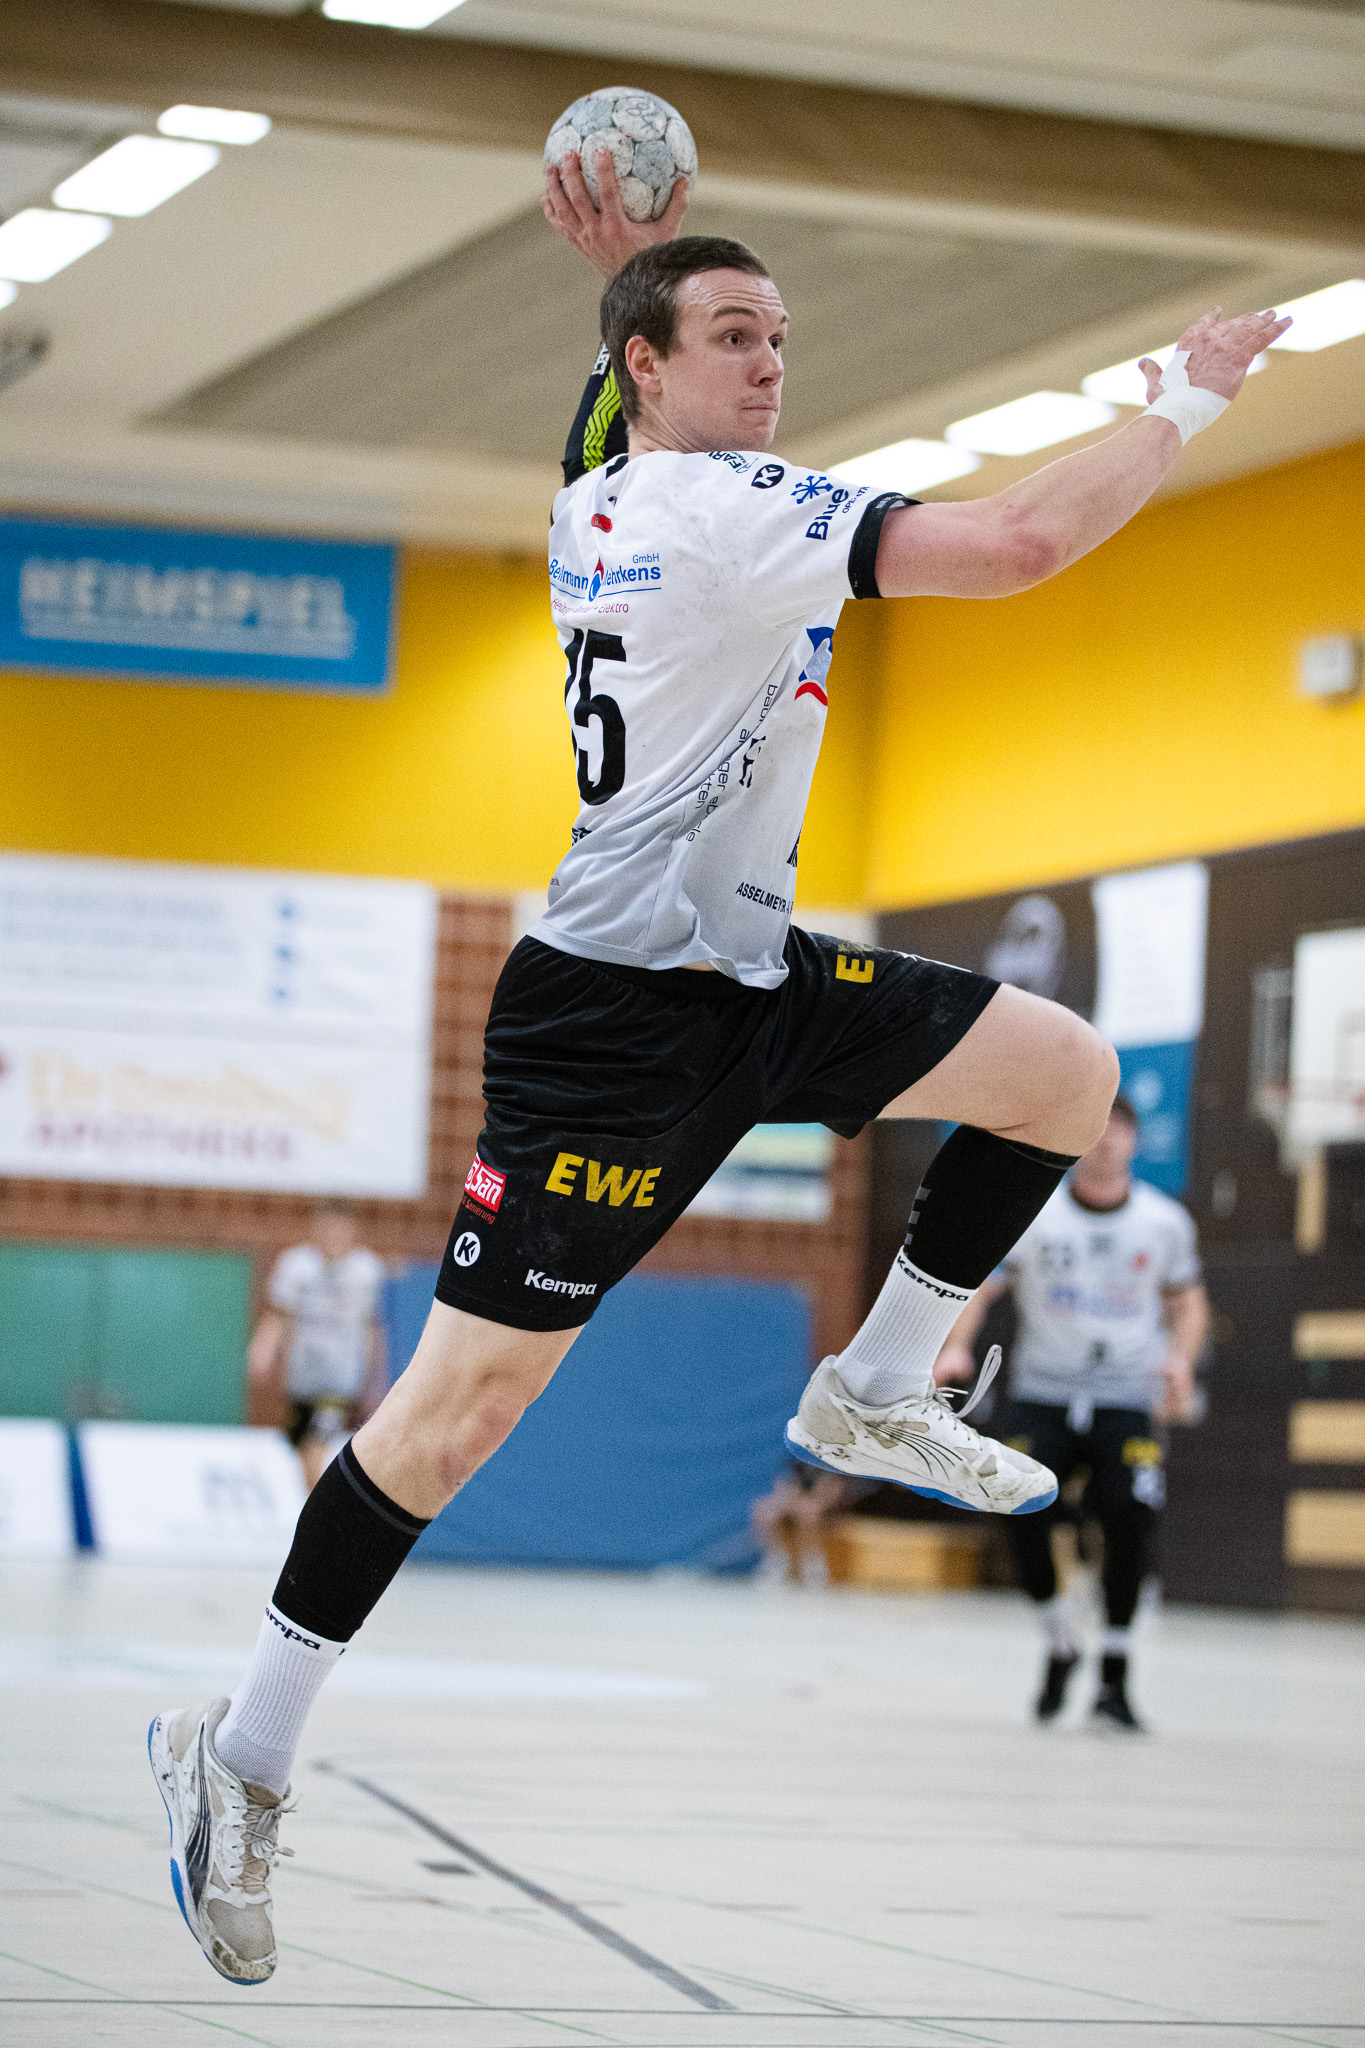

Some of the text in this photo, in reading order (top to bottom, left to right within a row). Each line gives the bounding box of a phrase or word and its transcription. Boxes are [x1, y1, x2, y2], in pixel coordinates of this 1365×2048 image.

[805, 488, 849, 541] Blue
[632, 553, 660, 564] GmbH
[545, 1152, 663, 1208] EWE
[524, 1268, 598, 1299] Kempa
